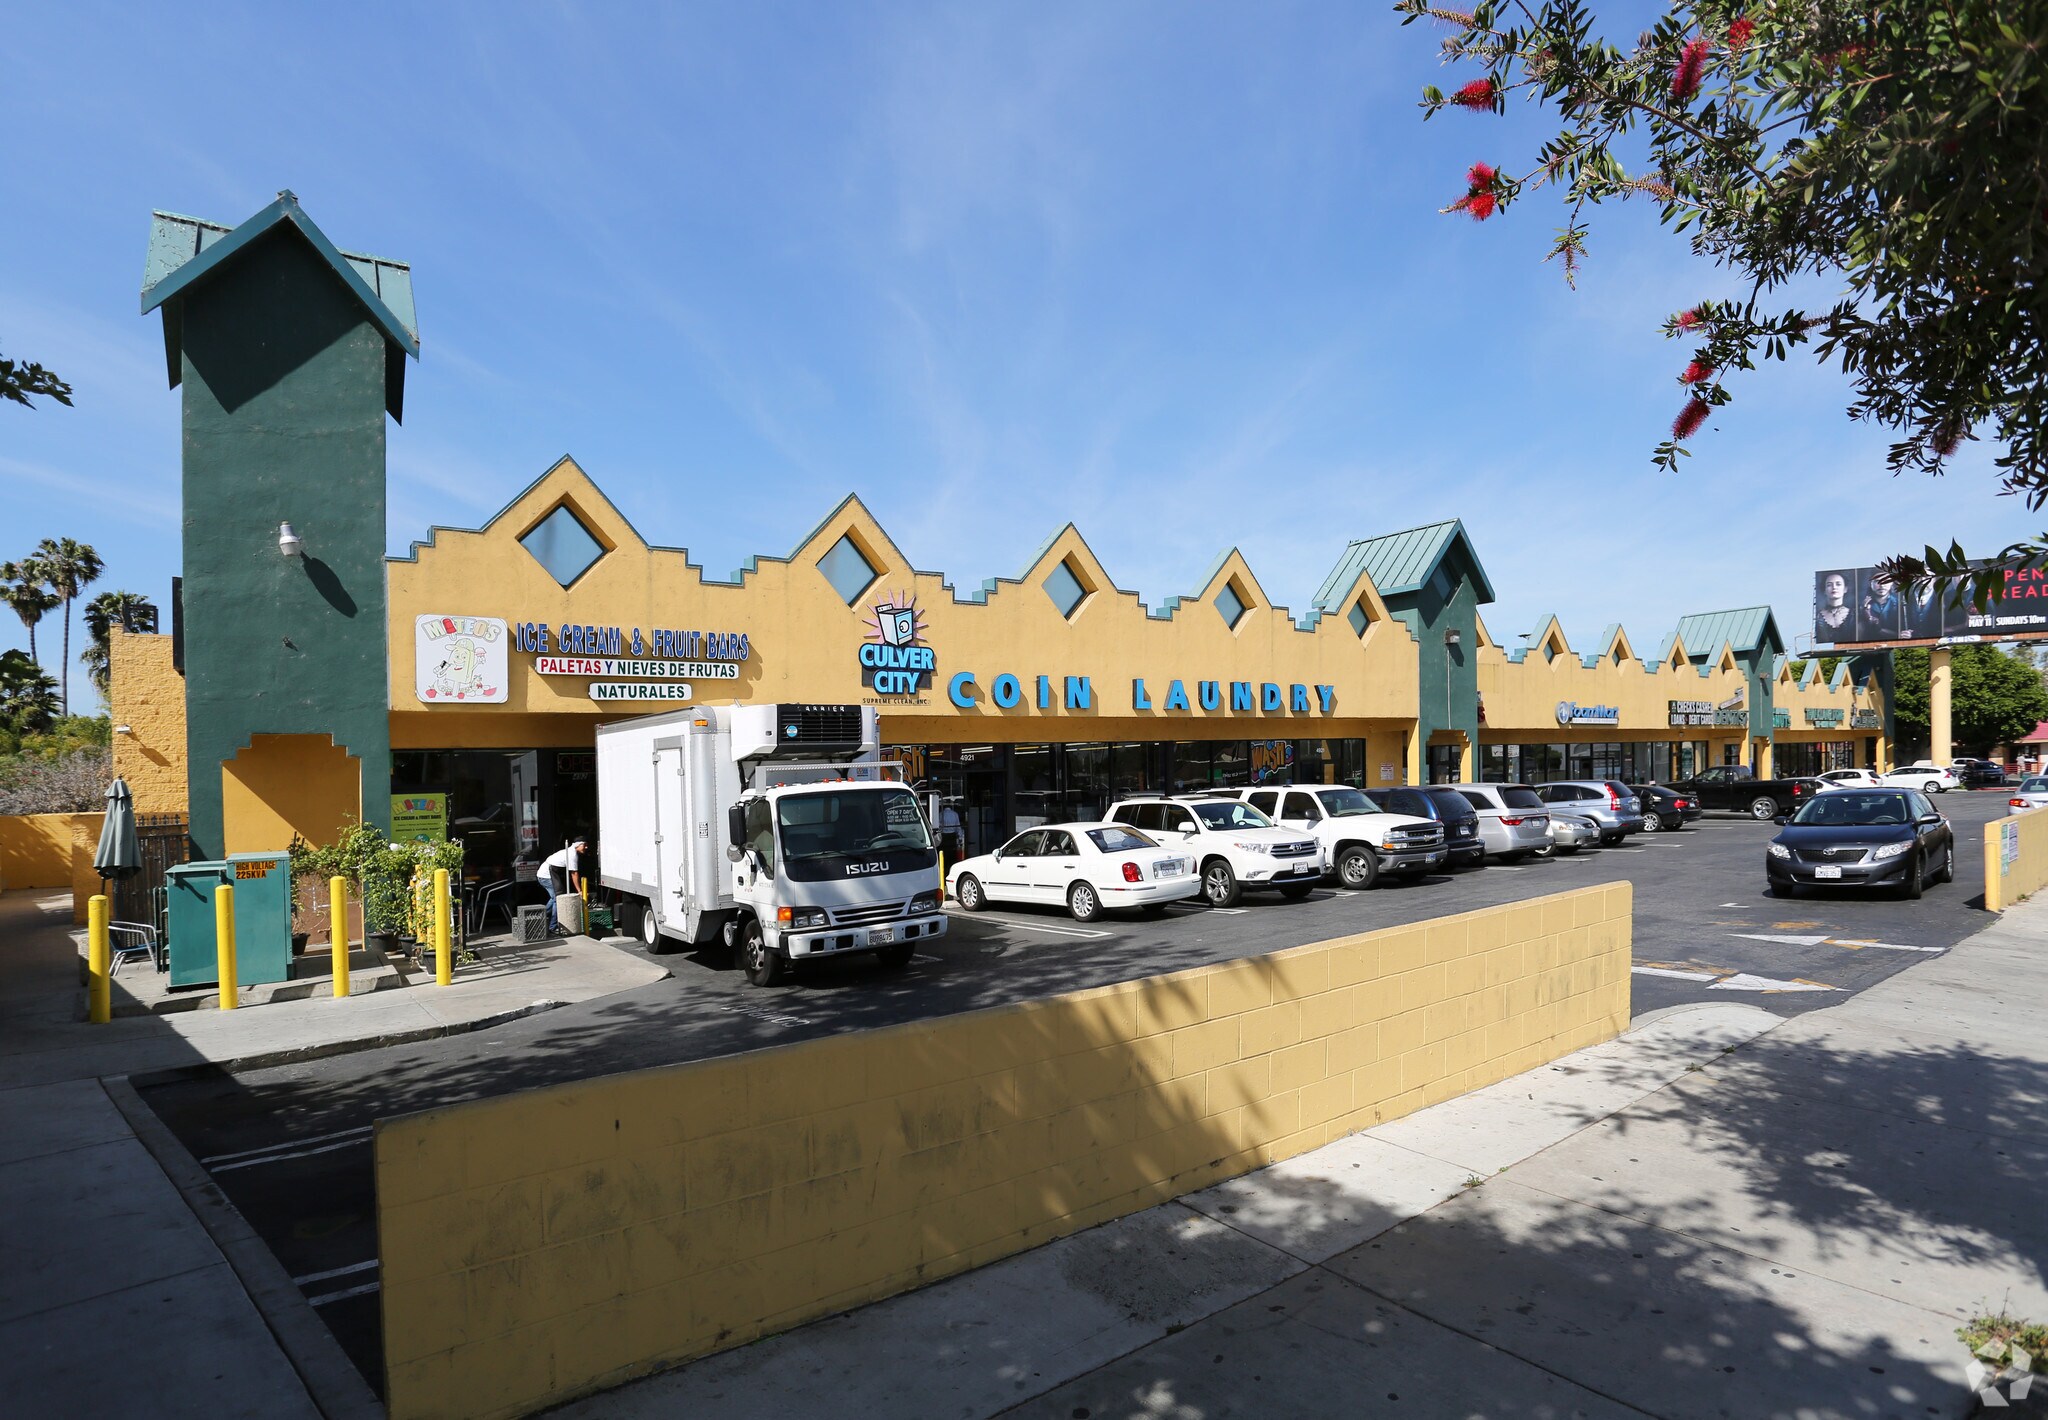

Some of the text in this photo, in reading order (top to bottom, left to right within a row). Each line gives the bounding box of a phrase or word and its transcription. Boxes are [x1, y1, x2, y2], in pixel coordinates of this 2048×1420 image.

[1968, 618, 1984, 628] MAY
[1985, 616, 1992, 627] 11
[1995, 615, 2028, 626] SUNDAYS
[516, 622, 749, 660] ICE CREAM & FRUIT BARS
[859, 643, 934, 670] CULVER
[541, 658, 736, 678] PALETAS Y NIEVES DE FRUTAS
[873, 670, 920, 694] CITY
[597, 685, 685, 699] NATURALES
[947, 671, 1335, 712] COIN LAUNDRY
[1677, 701, 1695, 713] CHECKS
[236, 860, 276, 870] HIGH VOLTAGE
[846, 861, 889, 874] ISUZU
[236, 870, 266, 879] 225KVA
